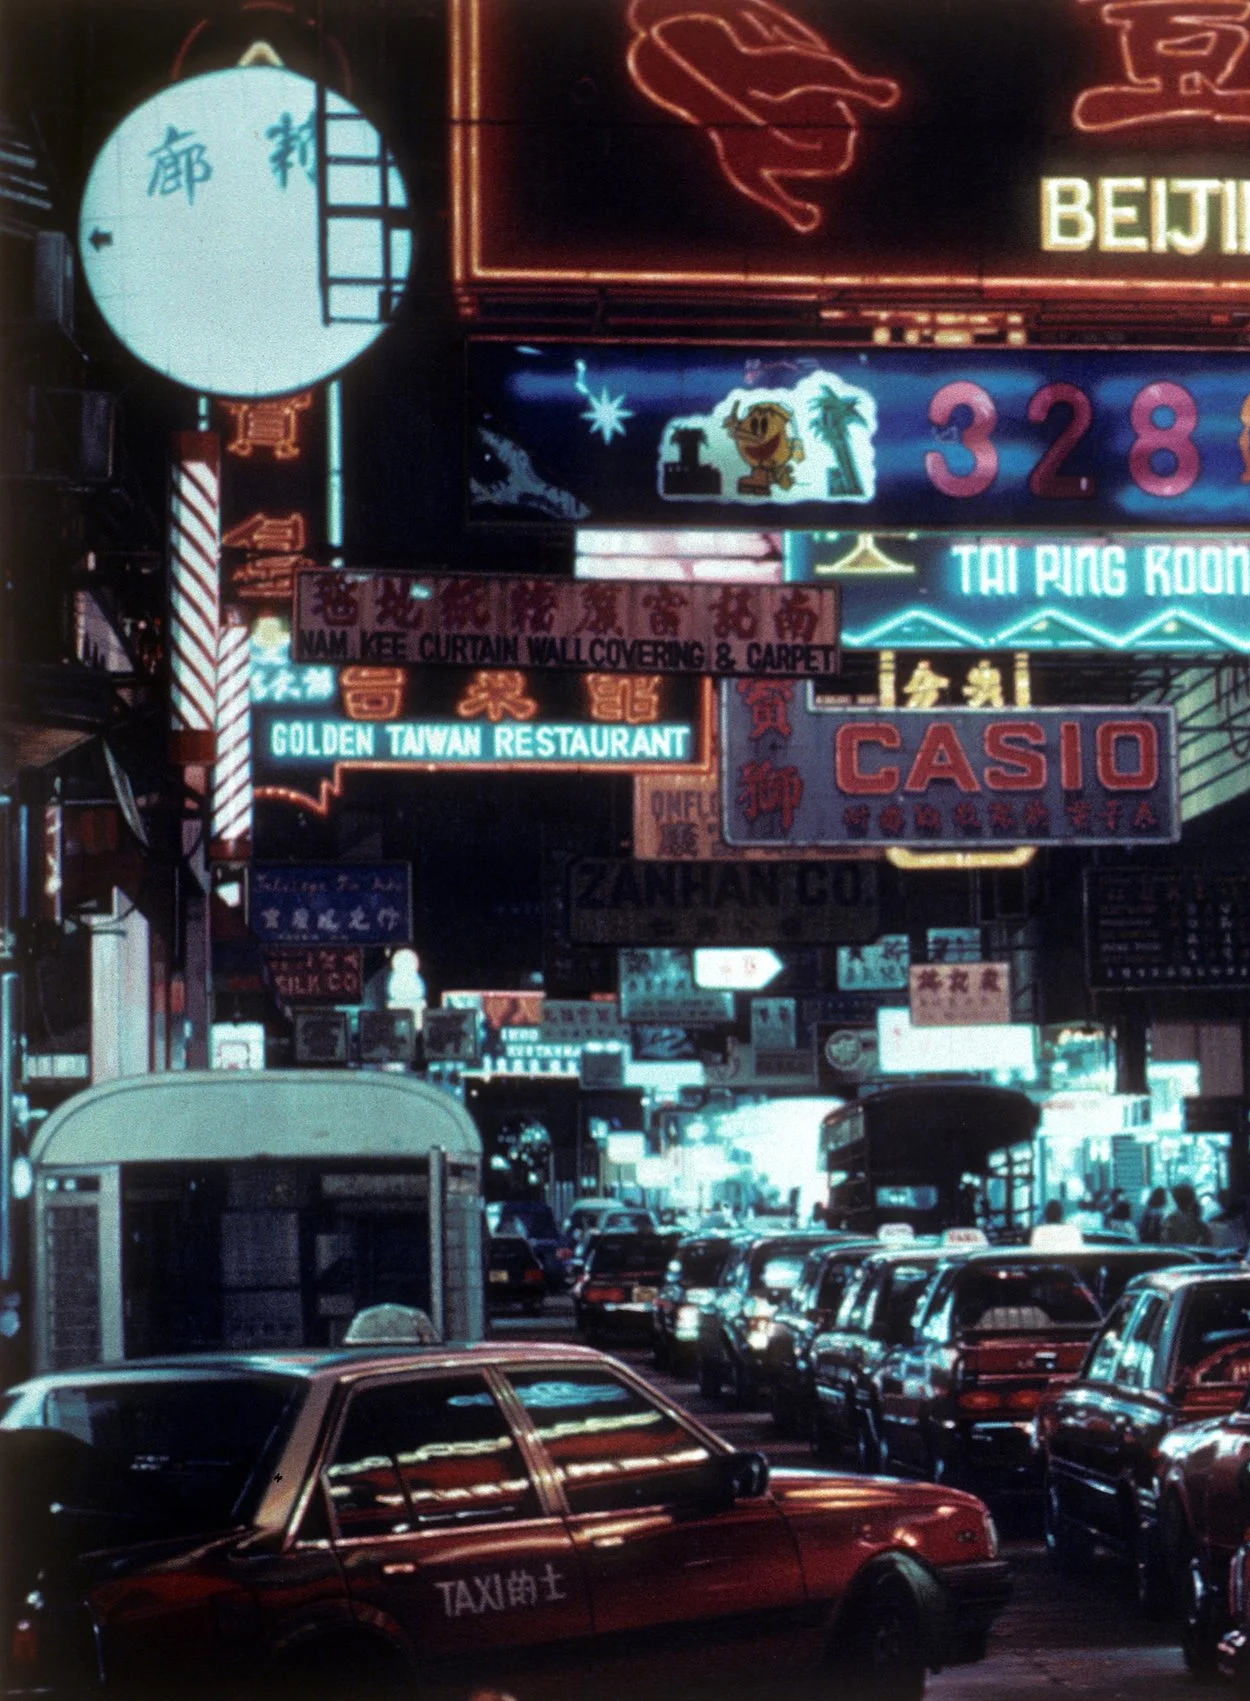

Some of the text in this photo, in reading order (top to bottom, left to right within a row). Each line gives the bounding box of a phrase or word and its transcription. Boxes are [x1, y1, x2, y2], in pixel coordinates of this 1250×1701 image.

[952, 546, 1019, 597] TAI
[1035, 546, 1127, 600] PING
[1144, 546, 1250, 600] KOON
[301, 630, 349, 661] NAM
[360, 632, 407, 662] KEE
[418, 633, 519, 665] CURTAIN
[714, 643, 735, 671] &
[746, 642, 836, 673] CARPET
[271, 722, 691, 760] GOLDEN TAIWAN RESTAURANT
[834, 720, 1160, 795] CASIO
